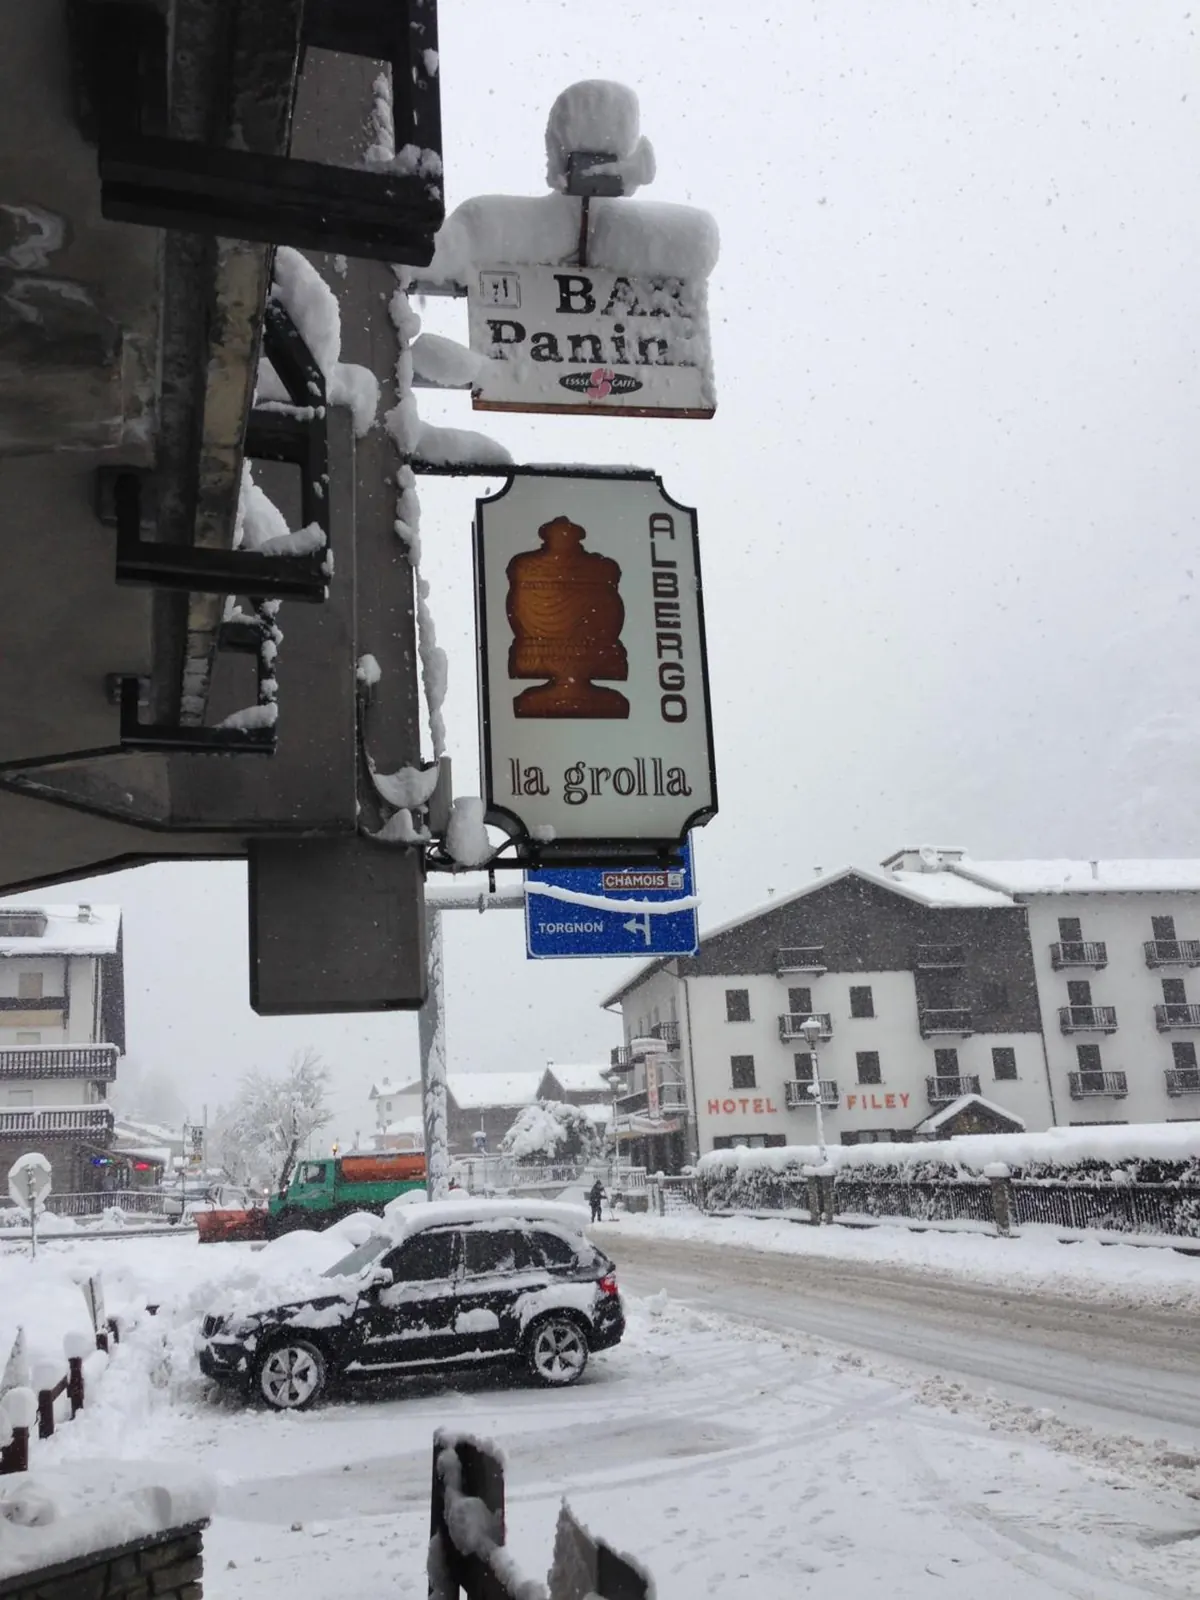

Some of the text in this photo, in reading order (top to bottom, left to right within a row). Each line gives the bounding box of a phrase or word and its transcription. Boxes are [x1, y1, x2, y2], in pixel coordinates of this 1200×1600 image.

[485, 318, 697, 367] Panin
[648, 512, 688, 724] ALBERGO
[508, 756, 693, 806] la grolla
[605, 875, 665, 887] CHAMOIS
[538, 921, 604, 934] TORGNON
[707, 1093, 911, 1115] HOTEL FILEY
